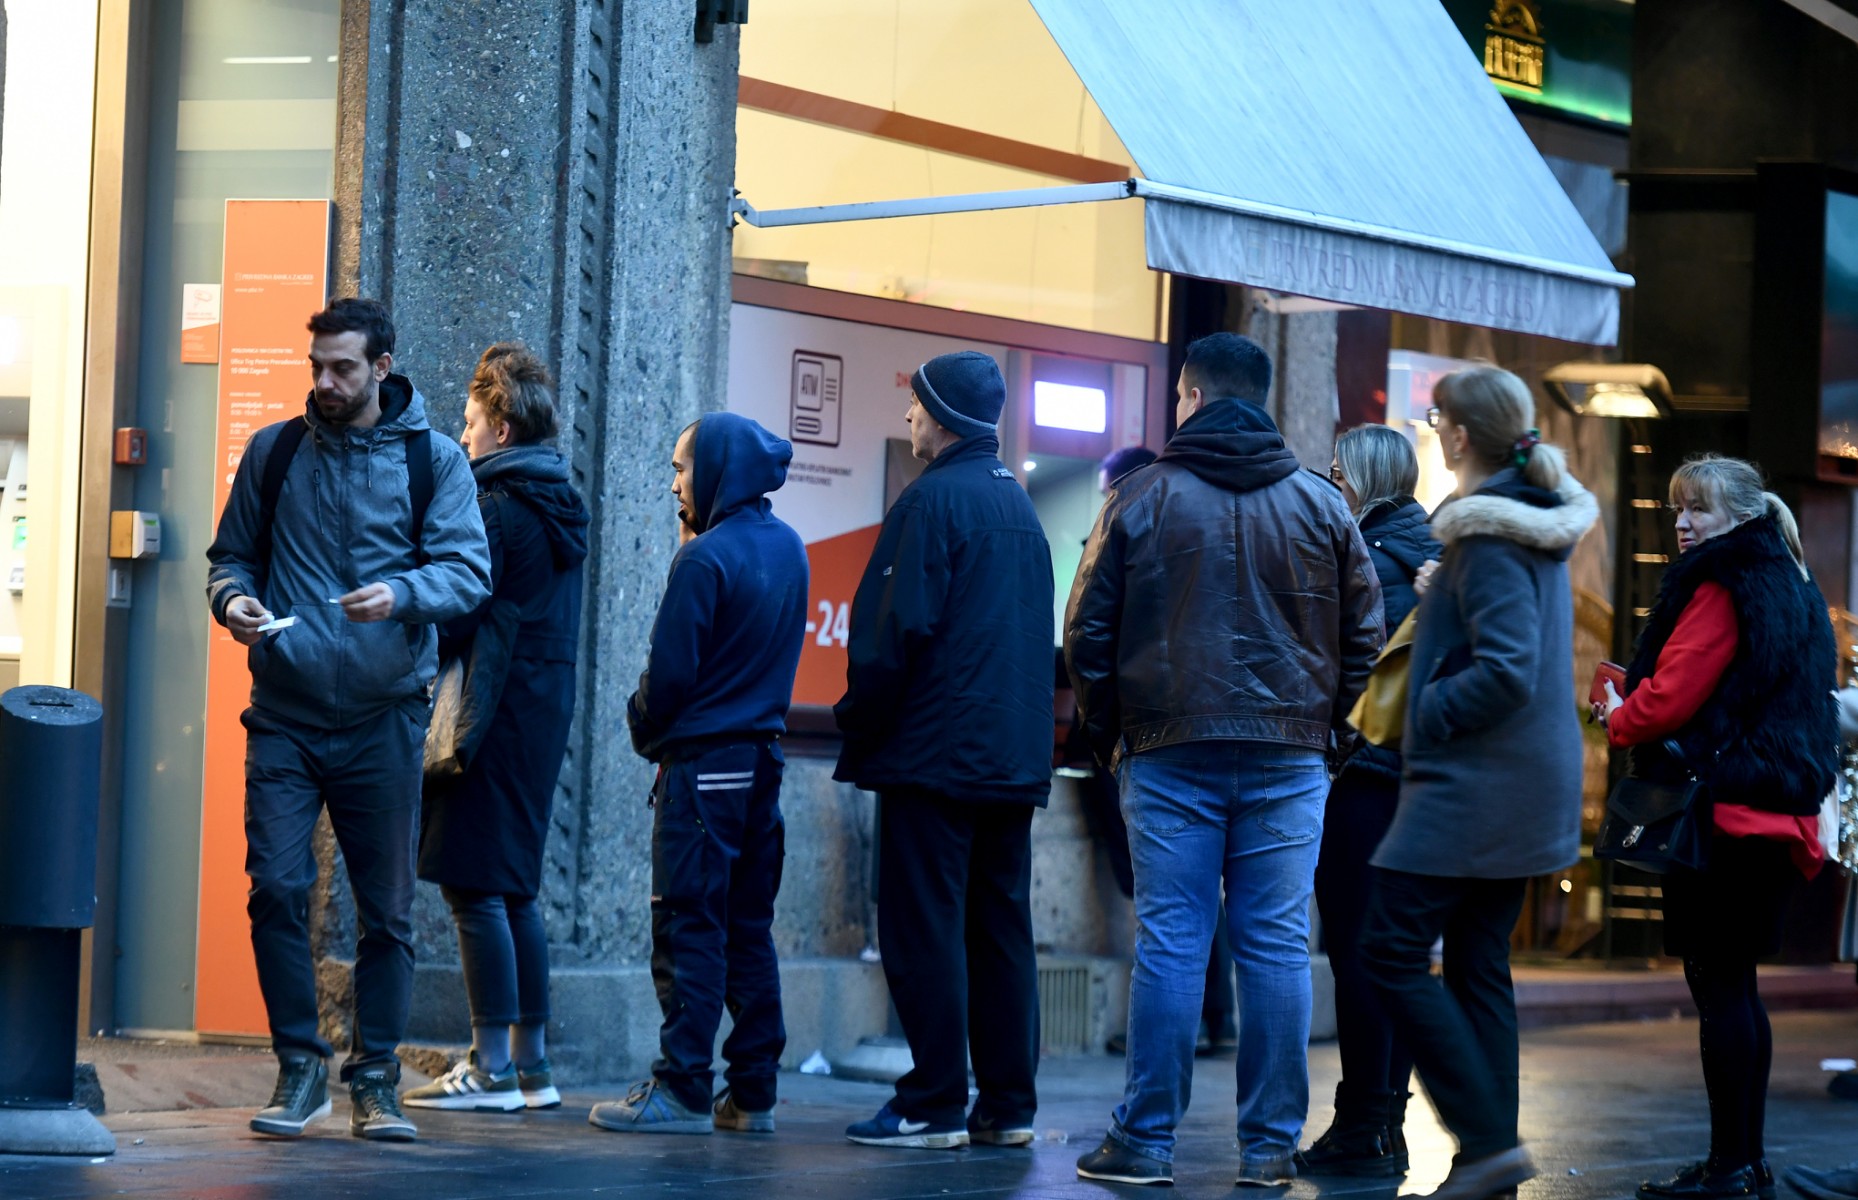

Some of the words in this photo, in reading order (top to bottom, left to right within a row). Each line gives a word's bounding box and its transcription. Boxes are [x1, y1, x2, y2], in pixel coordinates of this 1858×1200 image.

[1272, 239, 1387, 298] PRIVREDNA
[1394, 263, 1456, 310] BANKA
[1461, 276, 1534, 322] ZAGREB
[801, 374, 819, 397] ATM
